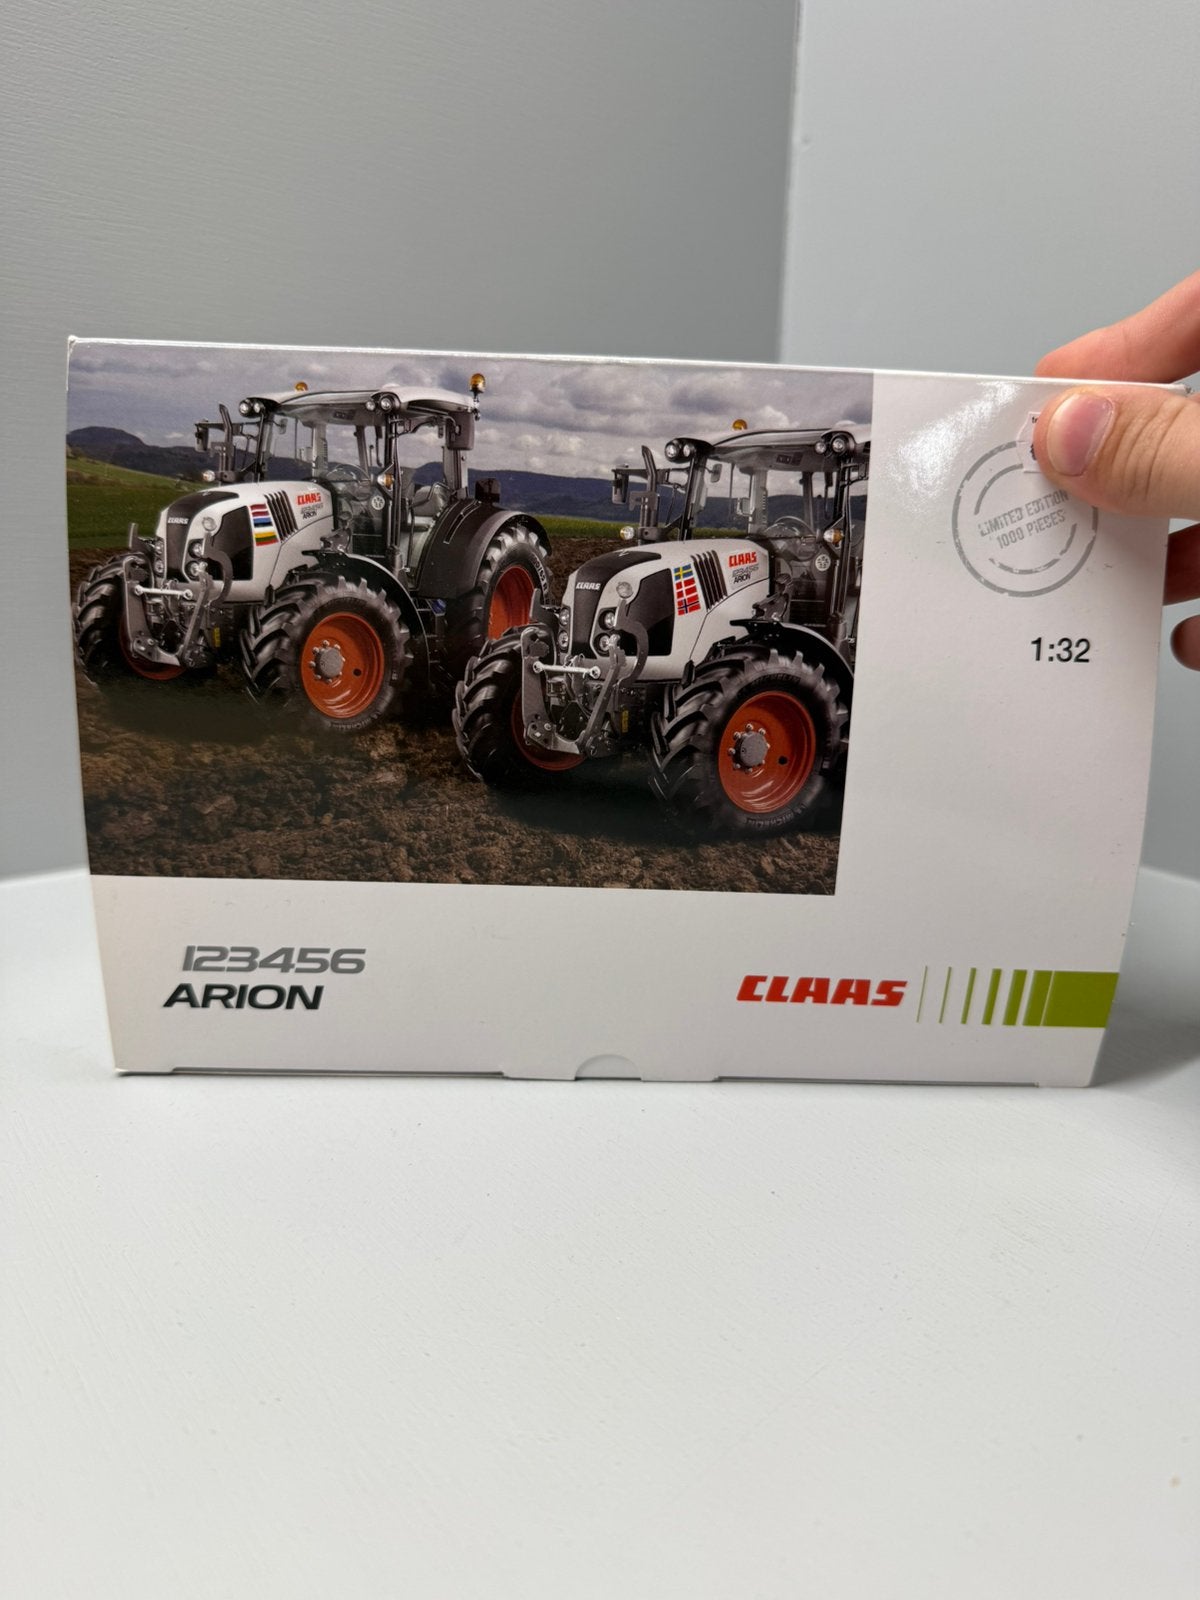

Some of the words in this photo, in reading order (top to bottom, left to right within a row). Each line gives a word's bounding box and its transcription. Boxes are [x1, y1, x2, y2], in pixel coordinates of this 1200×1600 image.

[296, 492, 322, 506] CLAAS
[996, 526, 1025, 549] 1000
[728, 551, 758, 568] CLAAS
[575, 581, 601, 591] CLAAS
[1030, 636, 1091, 663] 1:32
[181, 945, 367, 975] 123456
[162, 982, 325, 1011] ARION
[735, 974, 909, 1007] CLAAS
